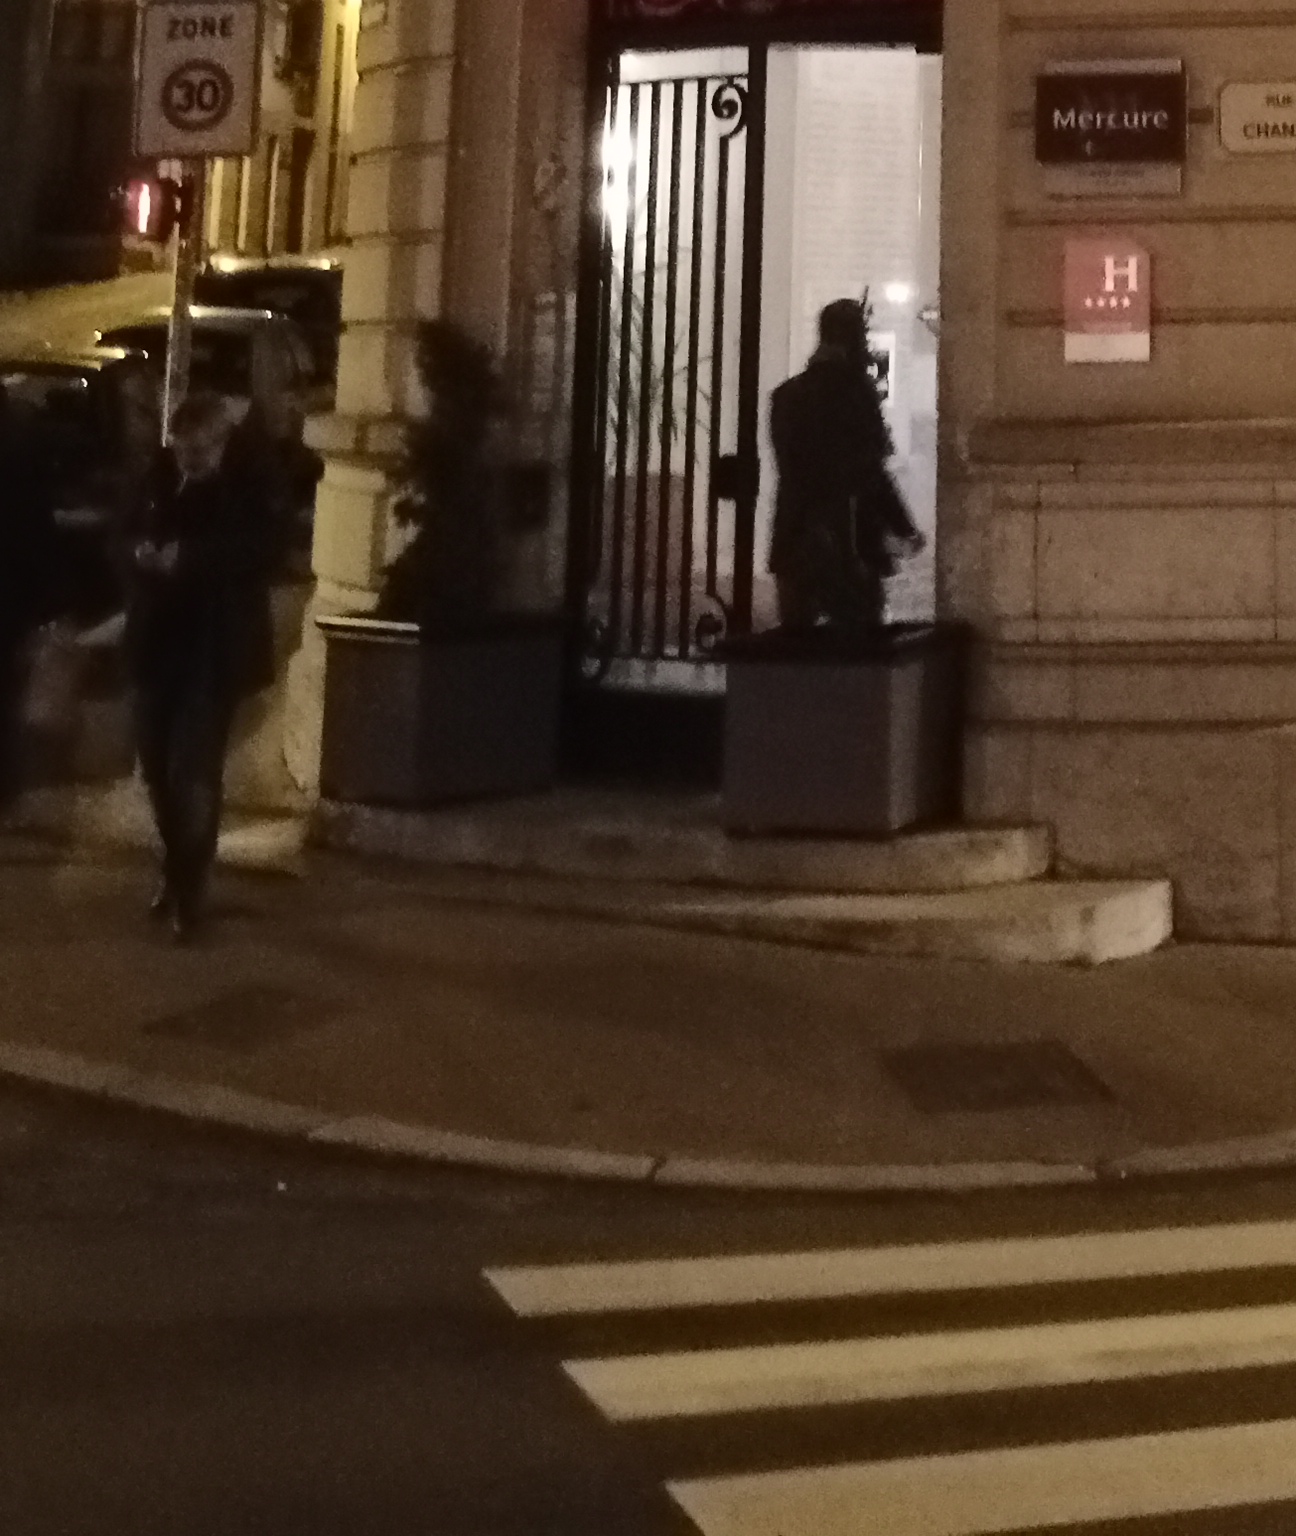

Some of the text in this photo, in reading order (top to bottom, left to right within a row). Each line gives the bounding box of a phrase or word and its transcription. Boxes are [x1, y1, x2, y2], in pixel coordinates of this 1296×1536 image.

[167, 16, 235, 40] ZONE
[173, 81, 221, 111] 30
[1052, 107, 1169, 130] Mercure
[1104, 254, 1138, 293] H
